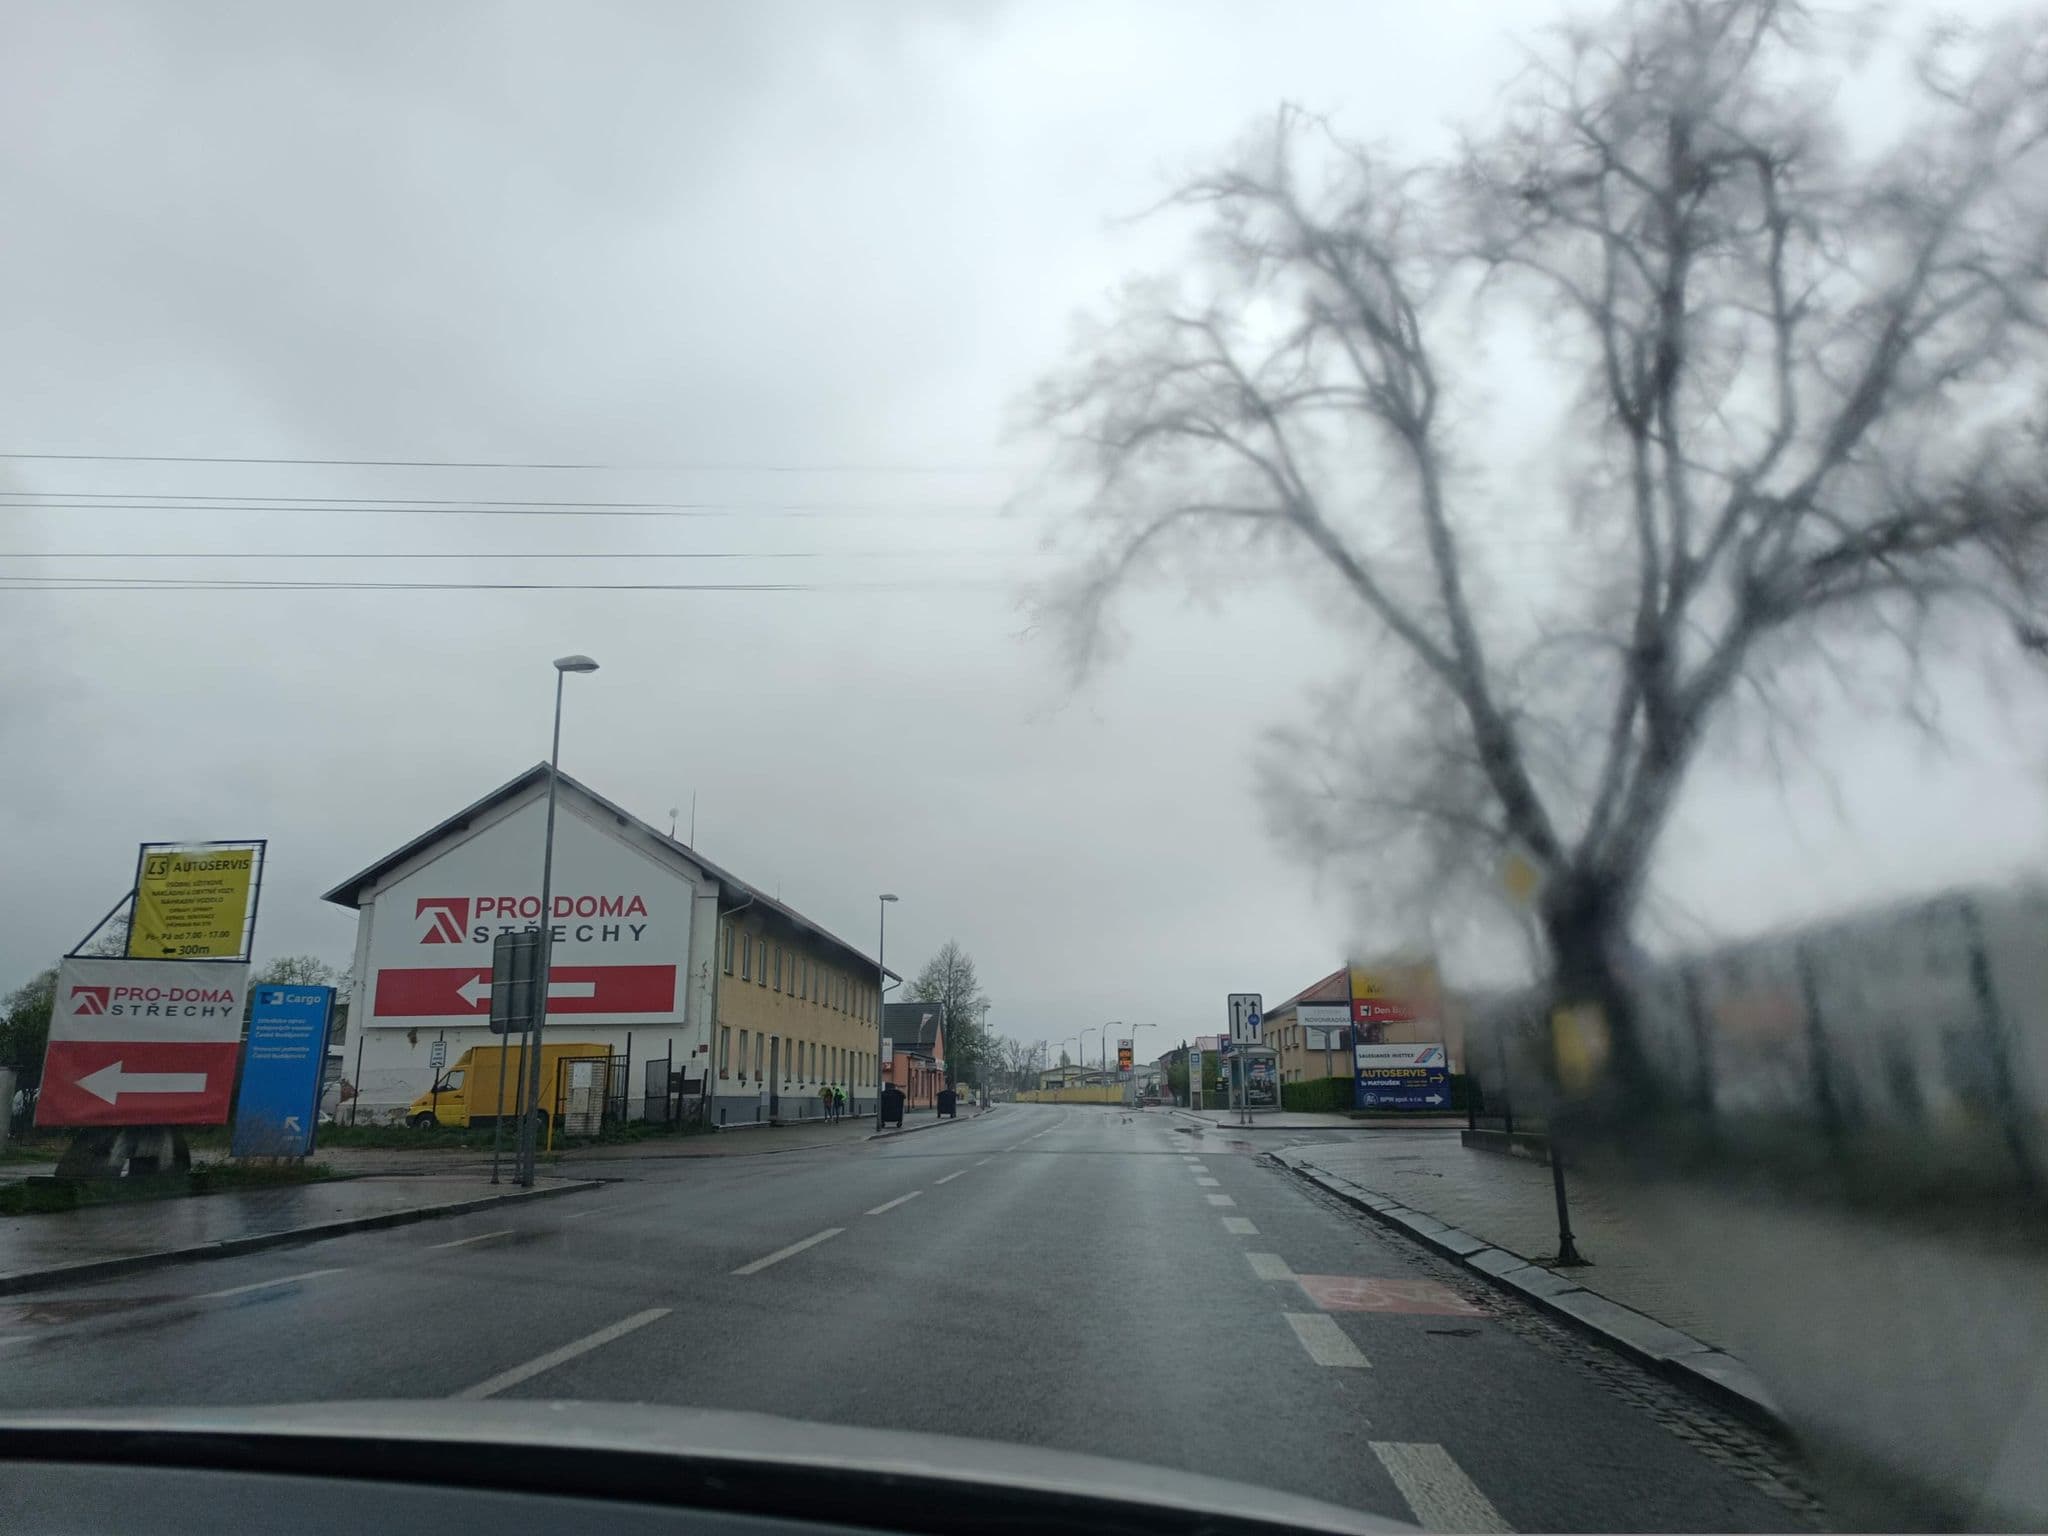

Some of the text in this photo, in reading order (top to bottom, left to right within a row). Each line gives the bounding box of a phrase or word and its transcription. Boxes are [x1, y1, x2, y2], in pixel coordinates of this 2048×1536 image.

[147, 859, 250, 875] LS AUTOSERVIS
[178, 944, 210, 955] 300m
[114, 987, 234, 1003] PRO-DOMA
[286, 994, 321, 1006] Cargo
[111, 1003, 233, 1017] STŘECHY
[1361, 1069, 1427, 1078] AUTOSERVIS
